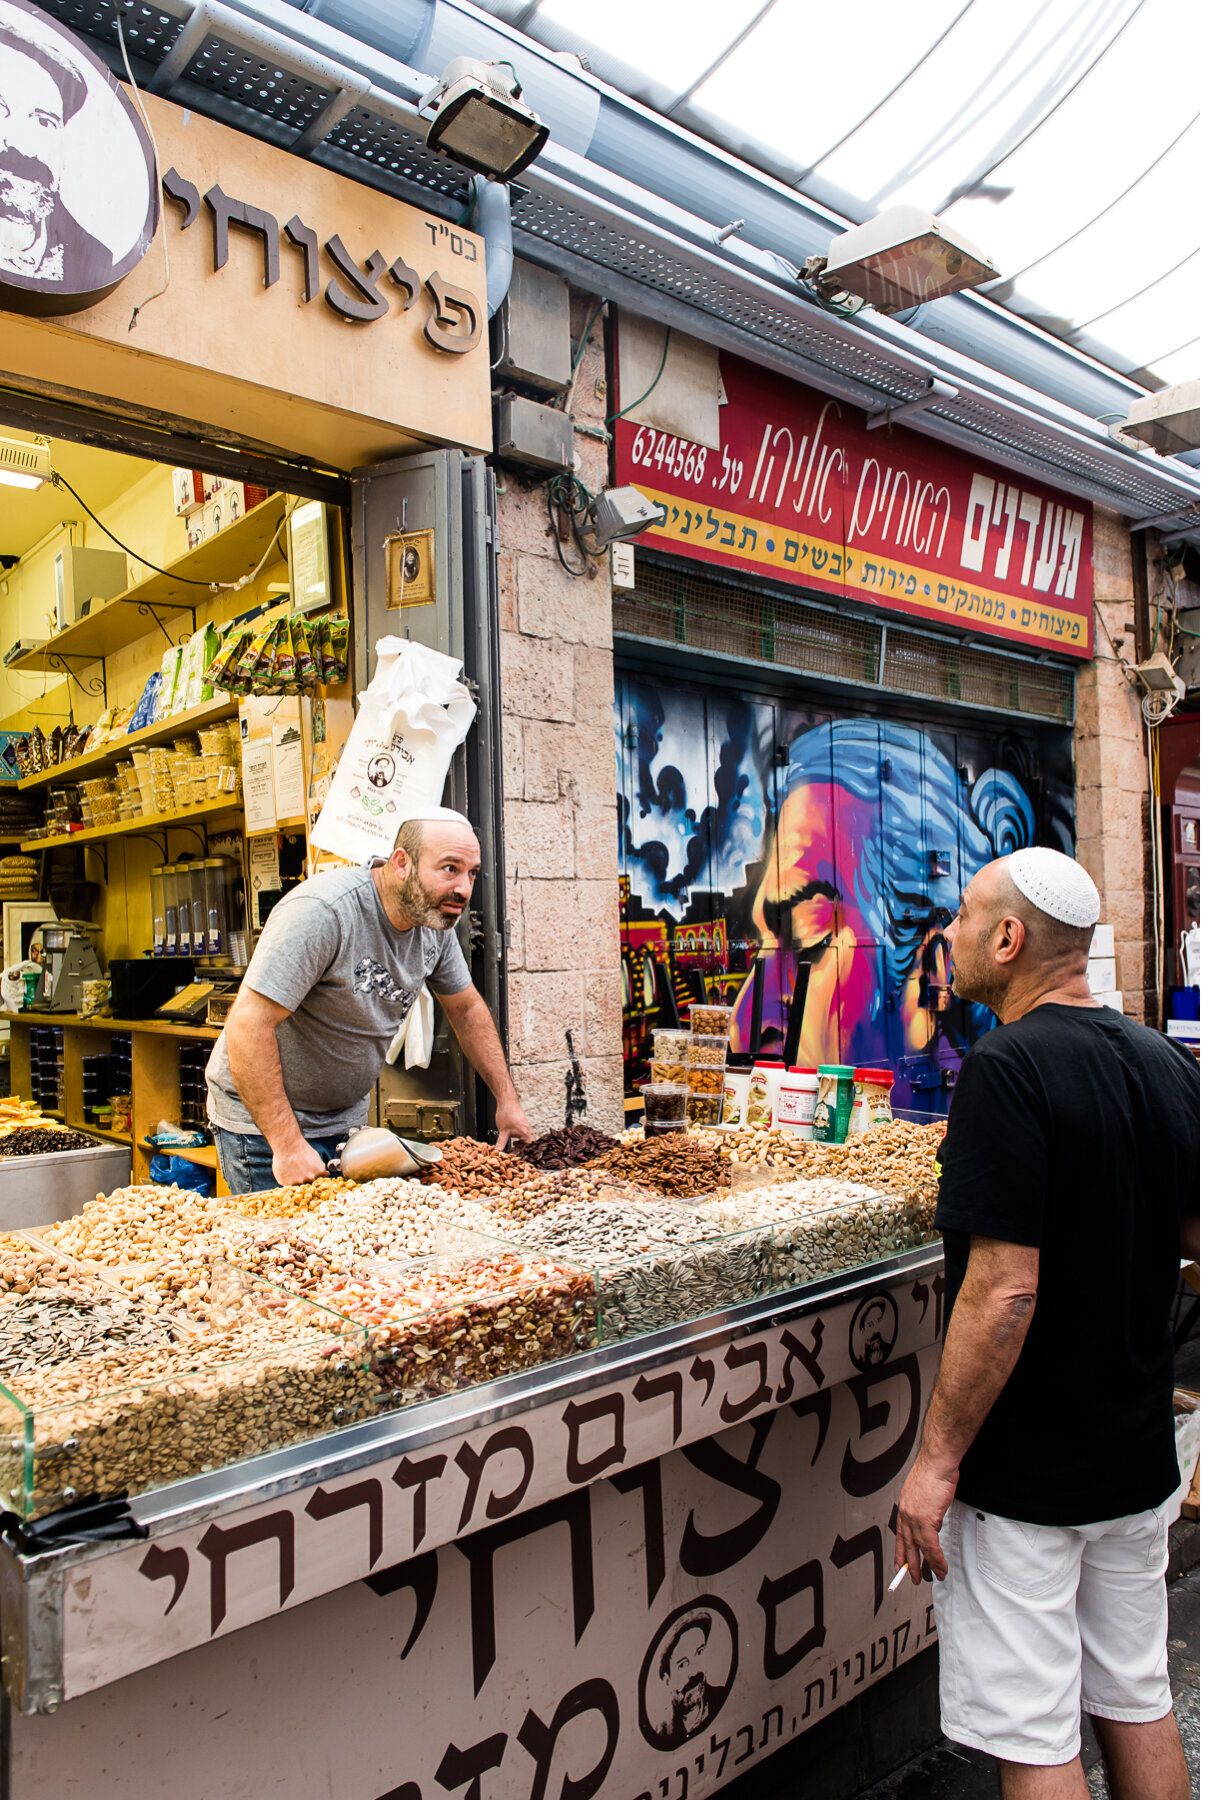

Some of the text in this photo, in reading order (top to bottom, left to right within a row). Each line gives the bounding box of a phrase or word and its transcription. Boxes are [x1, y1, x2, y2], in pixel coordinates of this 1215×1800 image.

[162, 167, 482, 354] פיצוחי
[632, 426, 707, 484] 6244568
[749, 400, 843, 524] אליהו
[784, 538, 853, 575] יבשים
[847, 458, 950, 559] האחים
[960, 472, 1085, 600] מעדנים
[861, 561, 917, 595] פירות
[937, 583, 1006, 620] ממתקים
[1021, 607, 1080, 640] פיצוחים
[138, 1317, 826, 1637] אבירם מזרחי
[362, 1352, 921, 1700] פיצוחי
